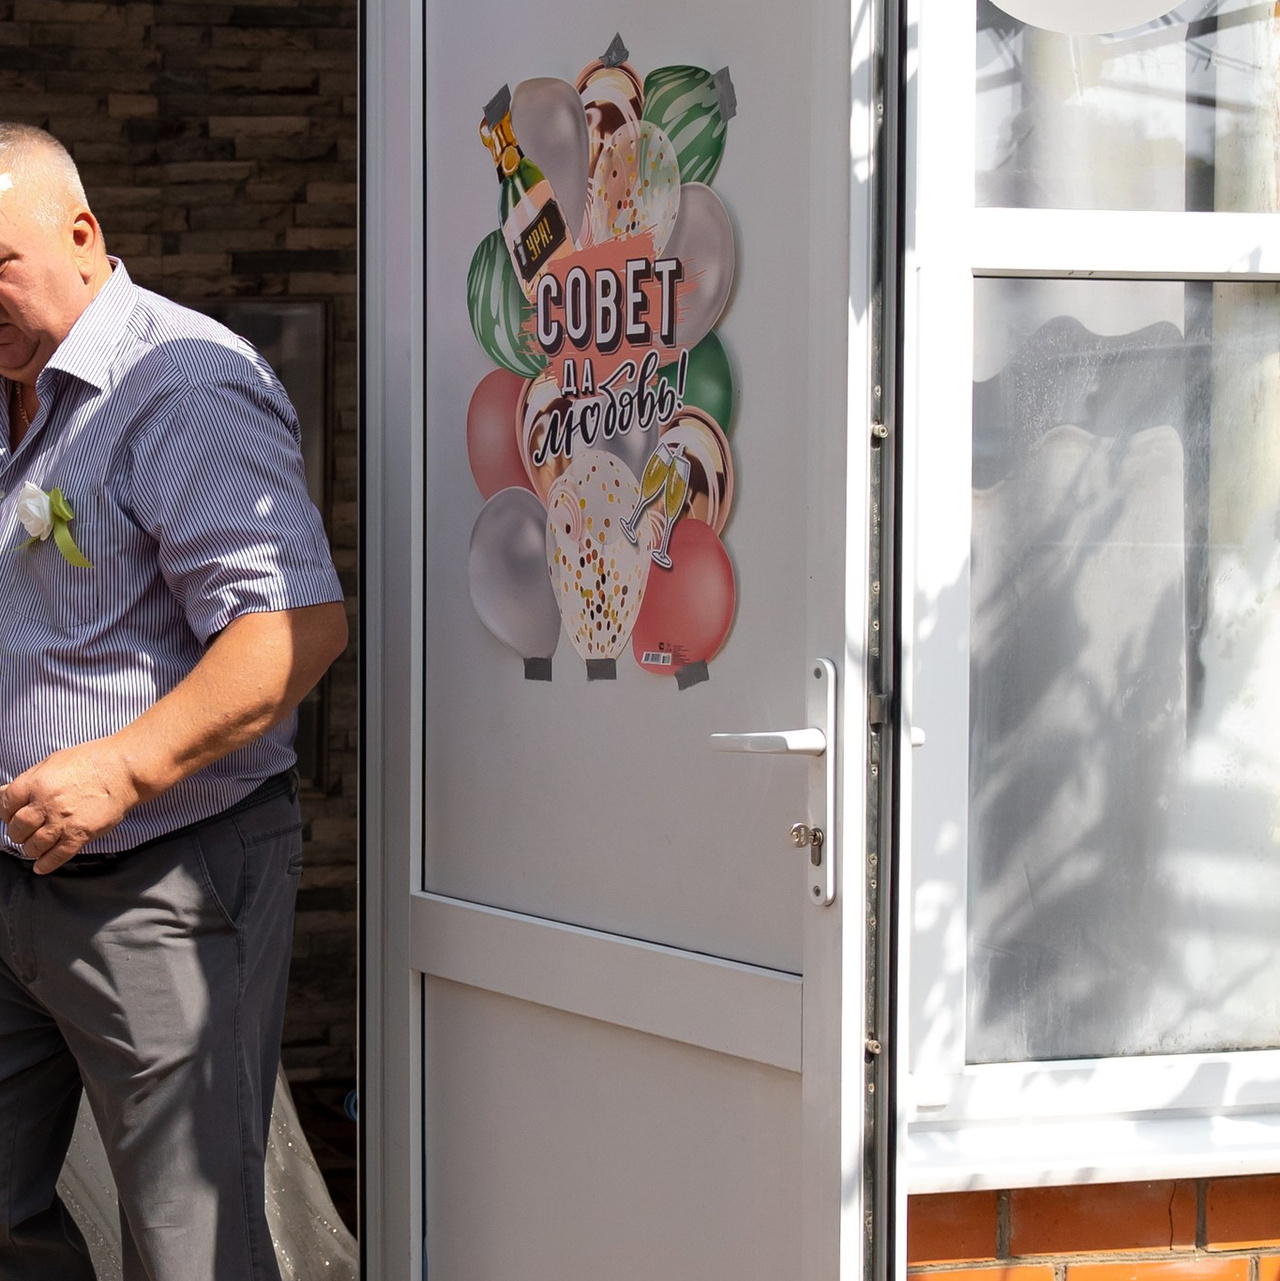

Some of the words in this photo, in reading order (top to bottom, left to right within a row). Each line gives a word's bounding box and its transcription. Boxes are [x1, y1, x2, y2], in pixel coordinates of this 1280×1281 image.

[525, 216, 554, 262] УРА!
[537, 257, 683, 352] СОВЕТ
[561, 359, 595, 398] ДА
